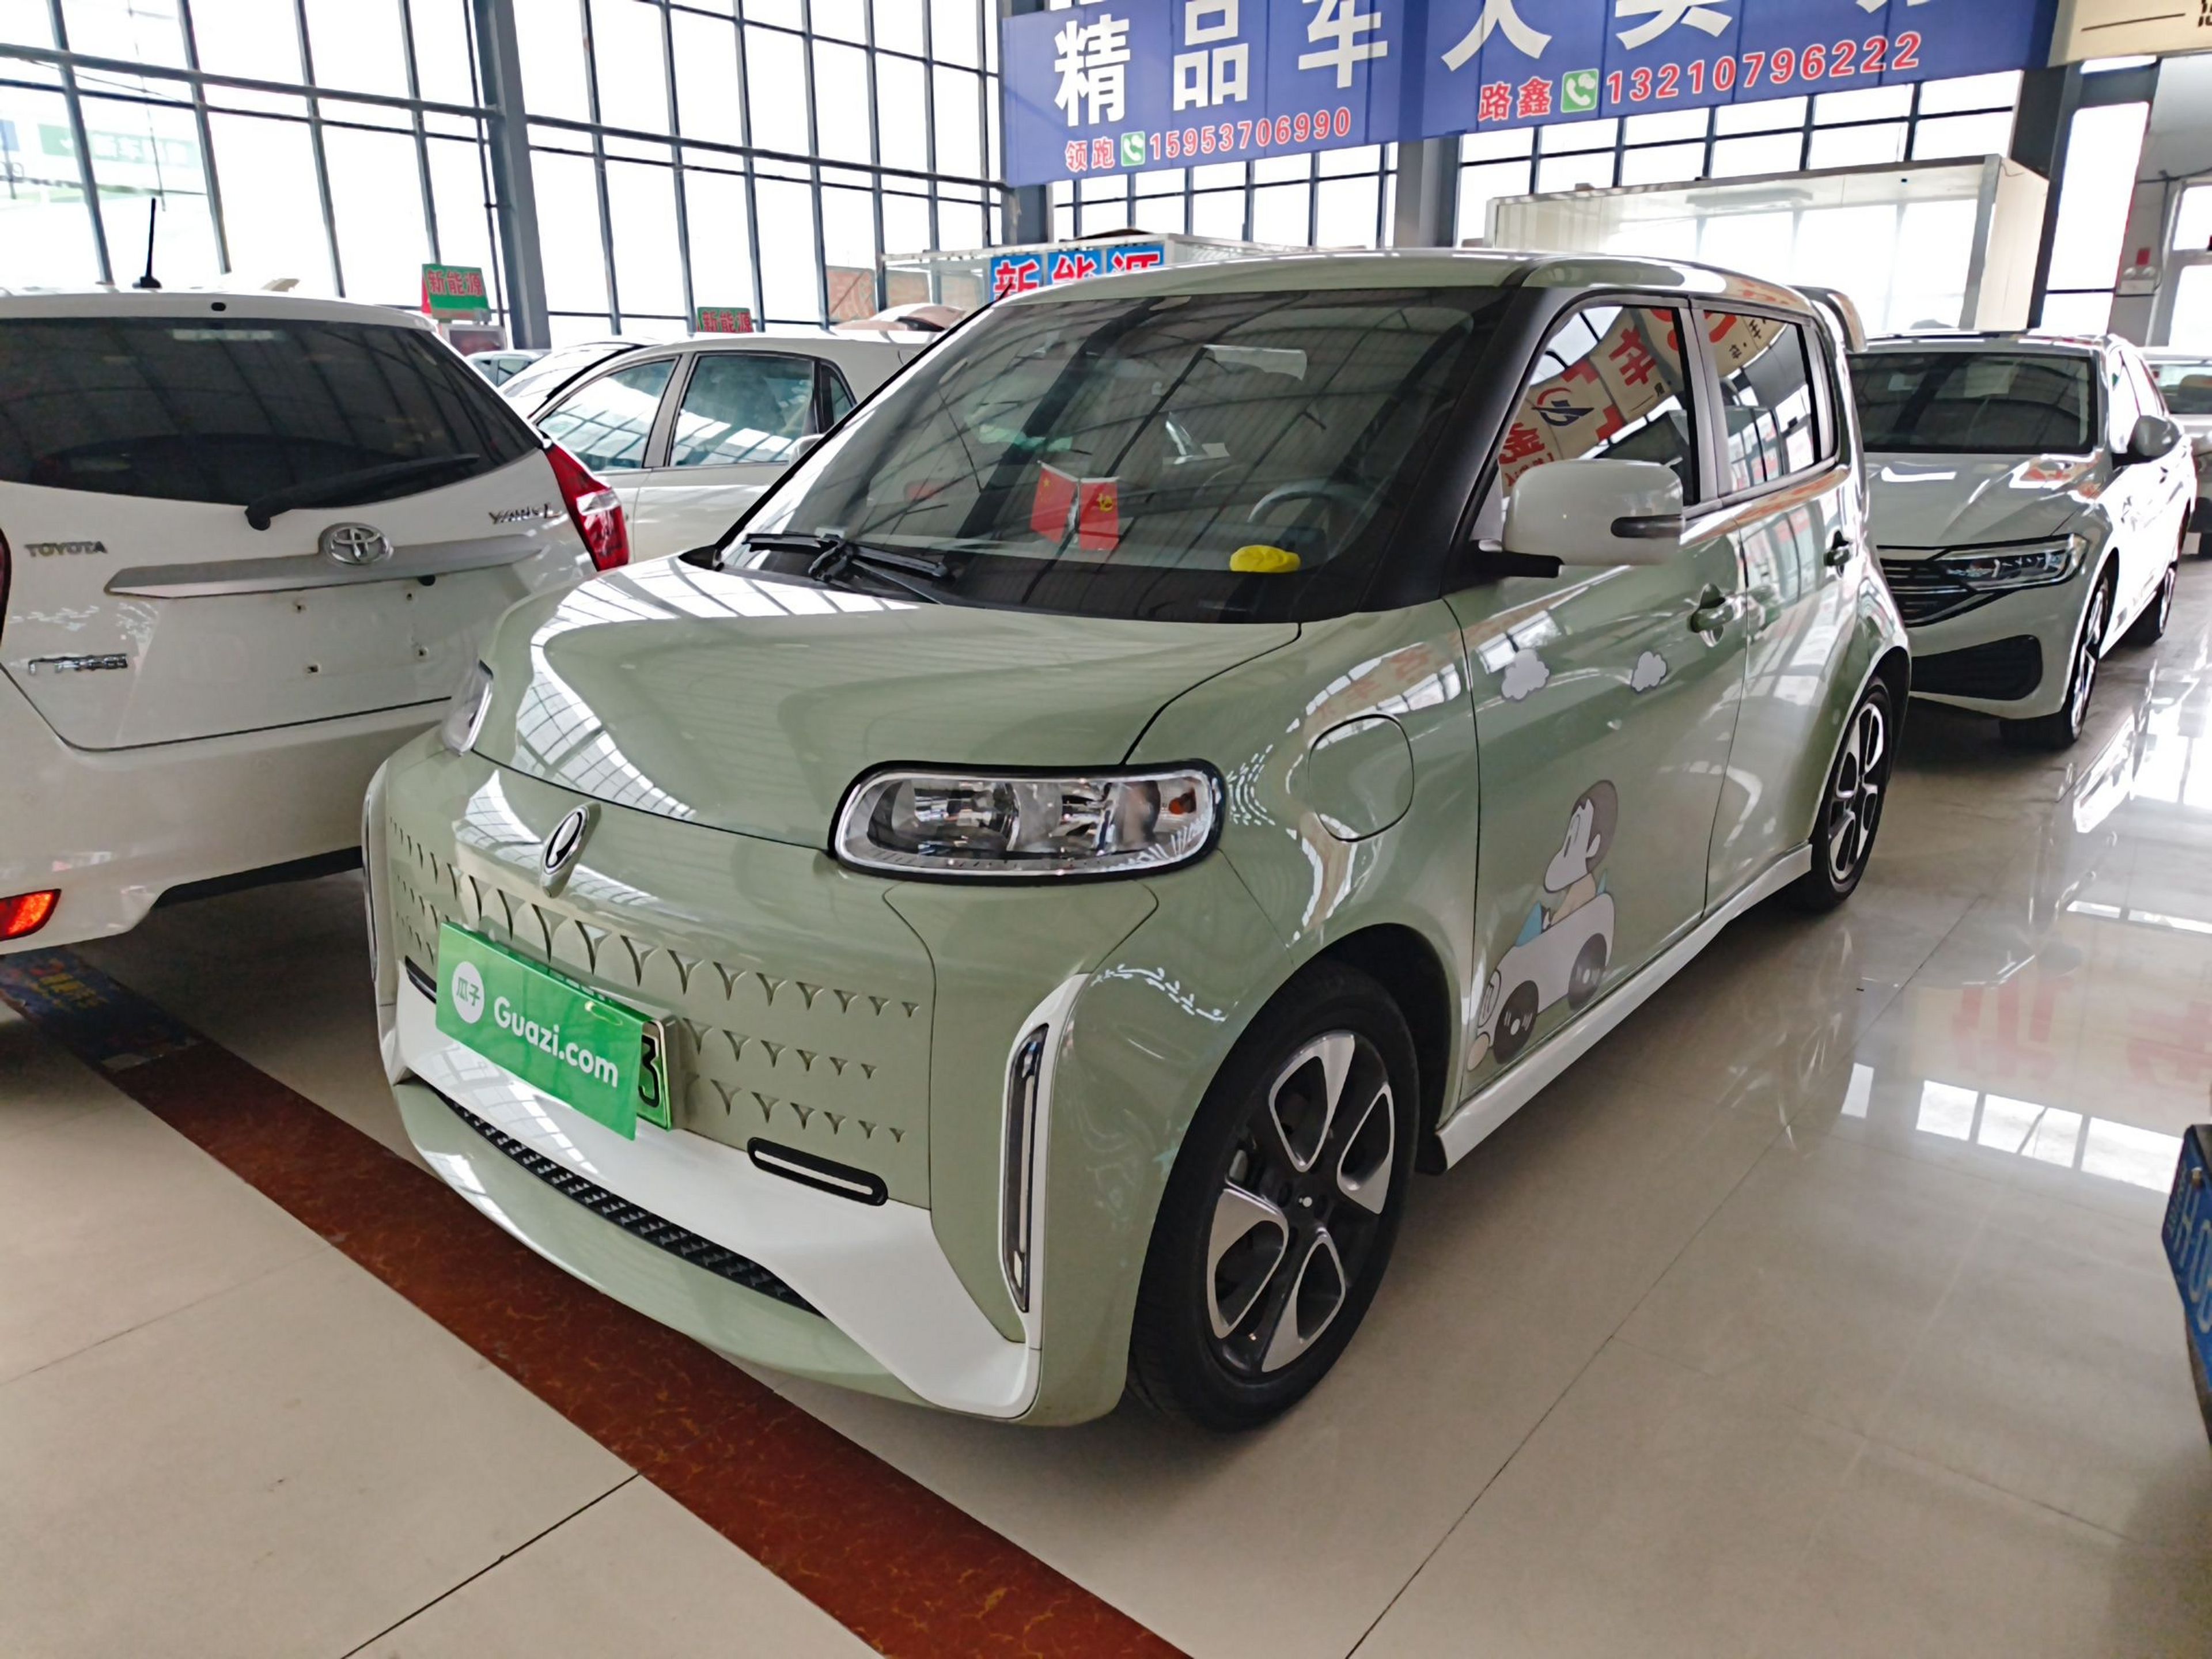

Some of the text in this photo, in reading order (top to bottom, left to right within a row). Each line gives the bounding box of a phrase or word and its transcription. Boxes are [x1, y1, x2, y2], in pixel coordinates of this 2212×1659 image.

[1478, 31, 1922, 122] 路鑫 13210796222
[1065, 107, 1352, 173] 领跑 15953706990
[427, 269, 484, 297] 新能源
[24, 540, 109, 558] TOYOTA
[456, 976, 480, 1007] 瓜子
[494, 996, 619, 1088] Guazi.com
